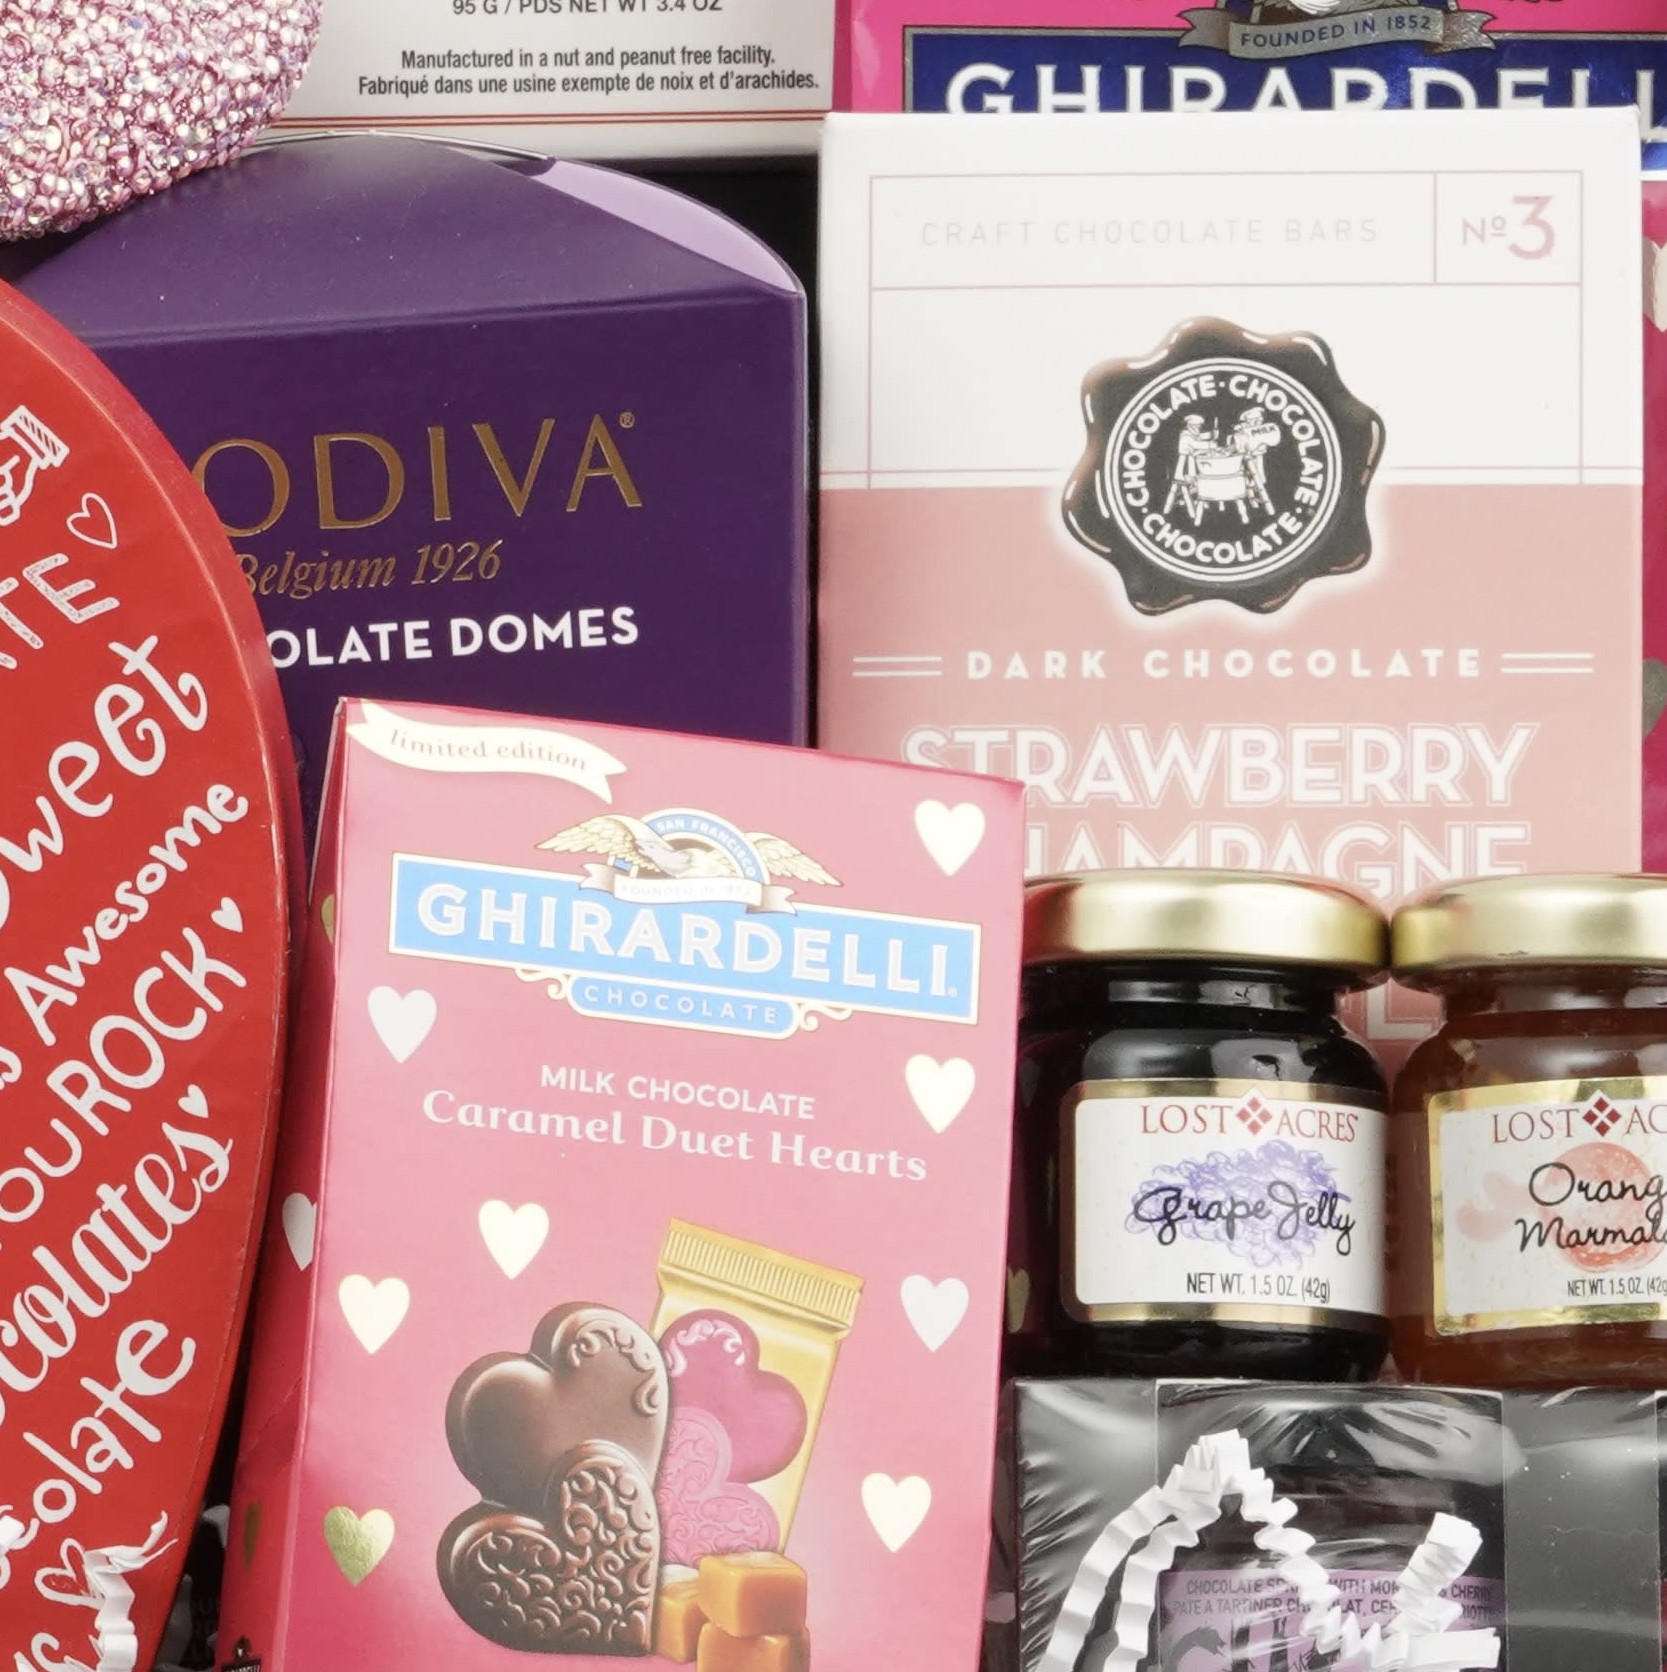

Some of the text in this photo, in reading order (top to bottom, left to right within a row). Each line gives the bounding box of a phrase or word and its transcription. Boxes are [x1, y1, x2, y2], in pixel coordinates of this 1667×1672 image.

[1241, 15, 1431, 48] FOUNDED IN 1852
[402, 45, 776, 72] Manufactured in a nut and peanut free facility.
[359, 69, 820, 98] Fabriqué dans une usine exempte de noix et d'arachides.
[921, 217, 1379, 246] CRAFT CHOCOLATE BARS
[1122, 374, 1325, 565] CHOCOLATE CHOCOLATE CHOCOLATE
[237, 540, 503, 600] Belgium 1926
[450, 606, 638, 656] DOMES
[967, 646, 1483, 681] DARK CHOCOLATE
[390, 728, 588, 773] limited edition
[902, 720, 1537, 810] STRAWBERRY
[3, 782, 250, 1047] Awesome
[418, 884, 948, 997] GHIRARDELLI
[584, 984, 779, 1026] CHOCOLATE
[541, 1065, 816, 1120] MILK CHOCOLATE
[423, 1089, 928, 1182] Caramel Duet Hearts
[1141, 1104, 1357, 1143] LOST ACRES
[1492, 1108, 1579, 1144] LOST
[1133, 1180, 1356, 1256] Grape Jelly
[1187, 1273, 1215, 1294] NET
[1221, 1273, 1245, 1295] WT.
[1250, 1275, 1272, 1297] 1.5
[1301, 1275, 1331, 1304] (42g)
